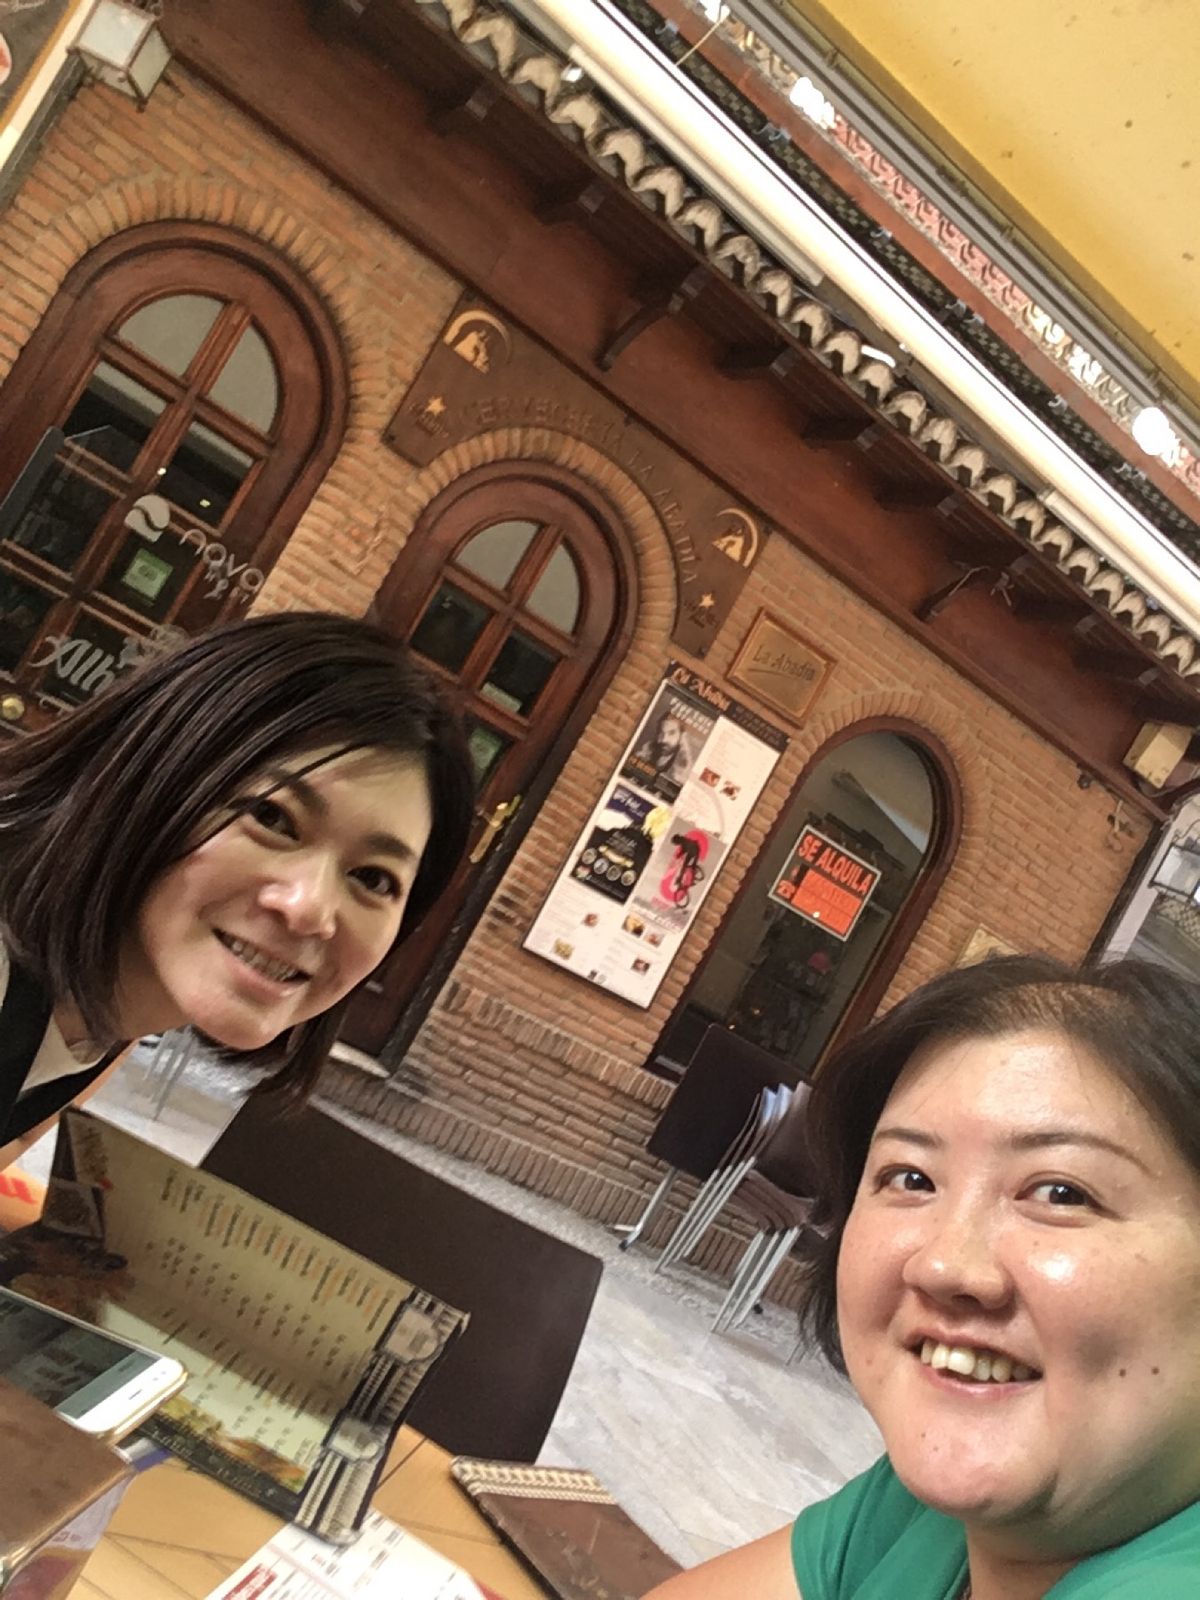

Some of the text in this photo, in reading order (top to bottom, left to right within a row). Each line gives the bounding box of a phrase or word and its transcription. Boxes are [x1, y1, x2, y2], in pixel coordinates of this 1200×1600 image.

[179, 529, 265, 591] nova
[799, 836, 872, 895] SE ALQUILA
